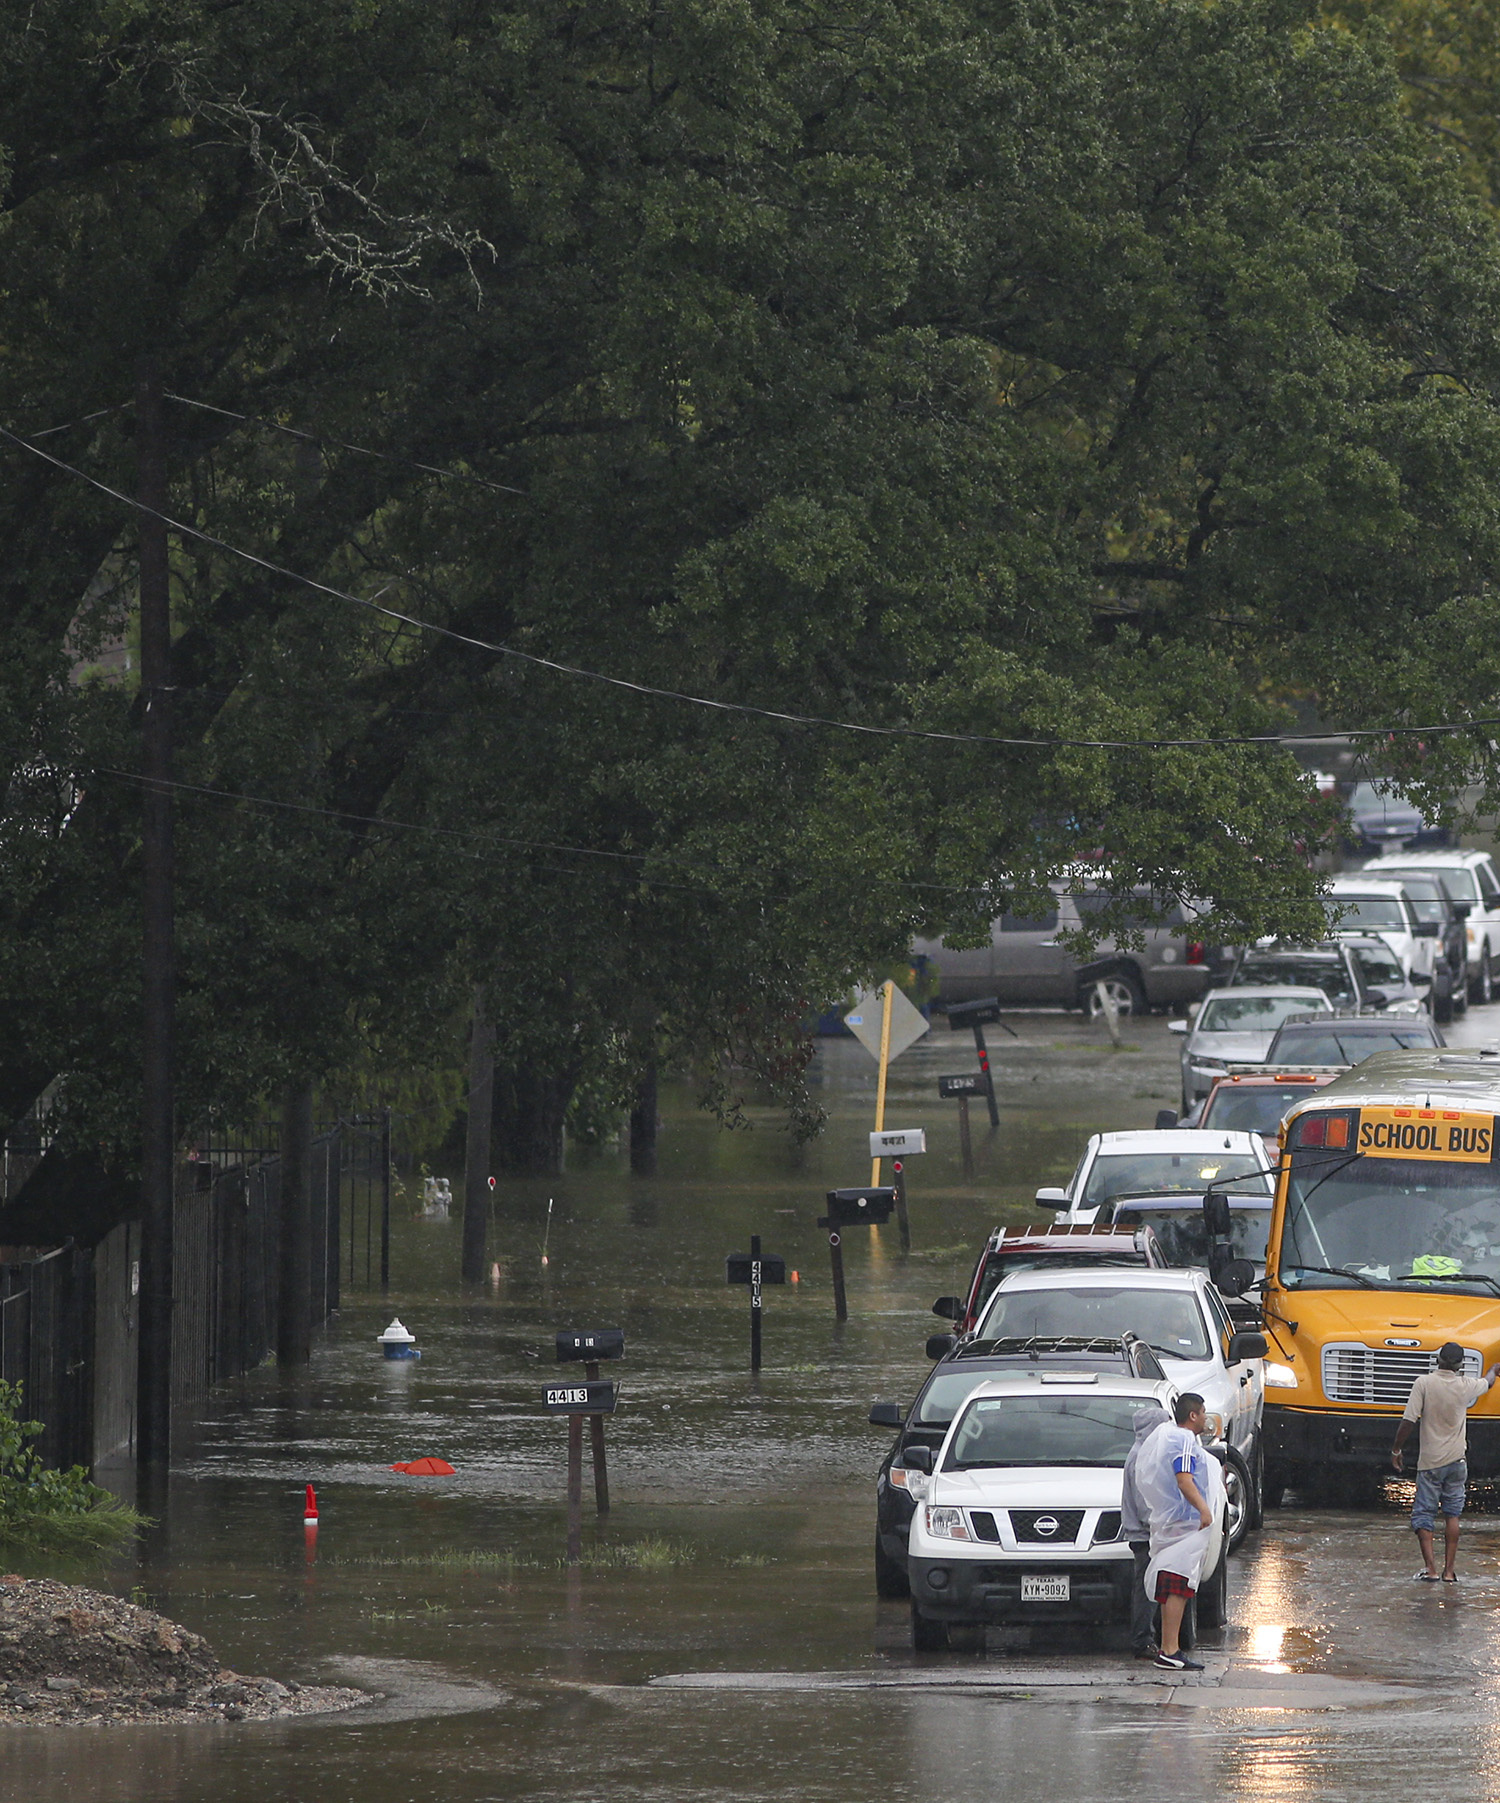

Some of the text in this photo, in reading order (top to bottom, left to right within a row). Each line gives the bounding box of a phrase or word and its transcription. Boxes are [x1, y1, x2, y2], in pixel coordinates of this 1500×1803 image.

[1360, 1121, 1491, 1154] SCHOOL BUS
[751, 1260, 762, 1308] 4415
[548, 1389, 587, 1404] 4413
